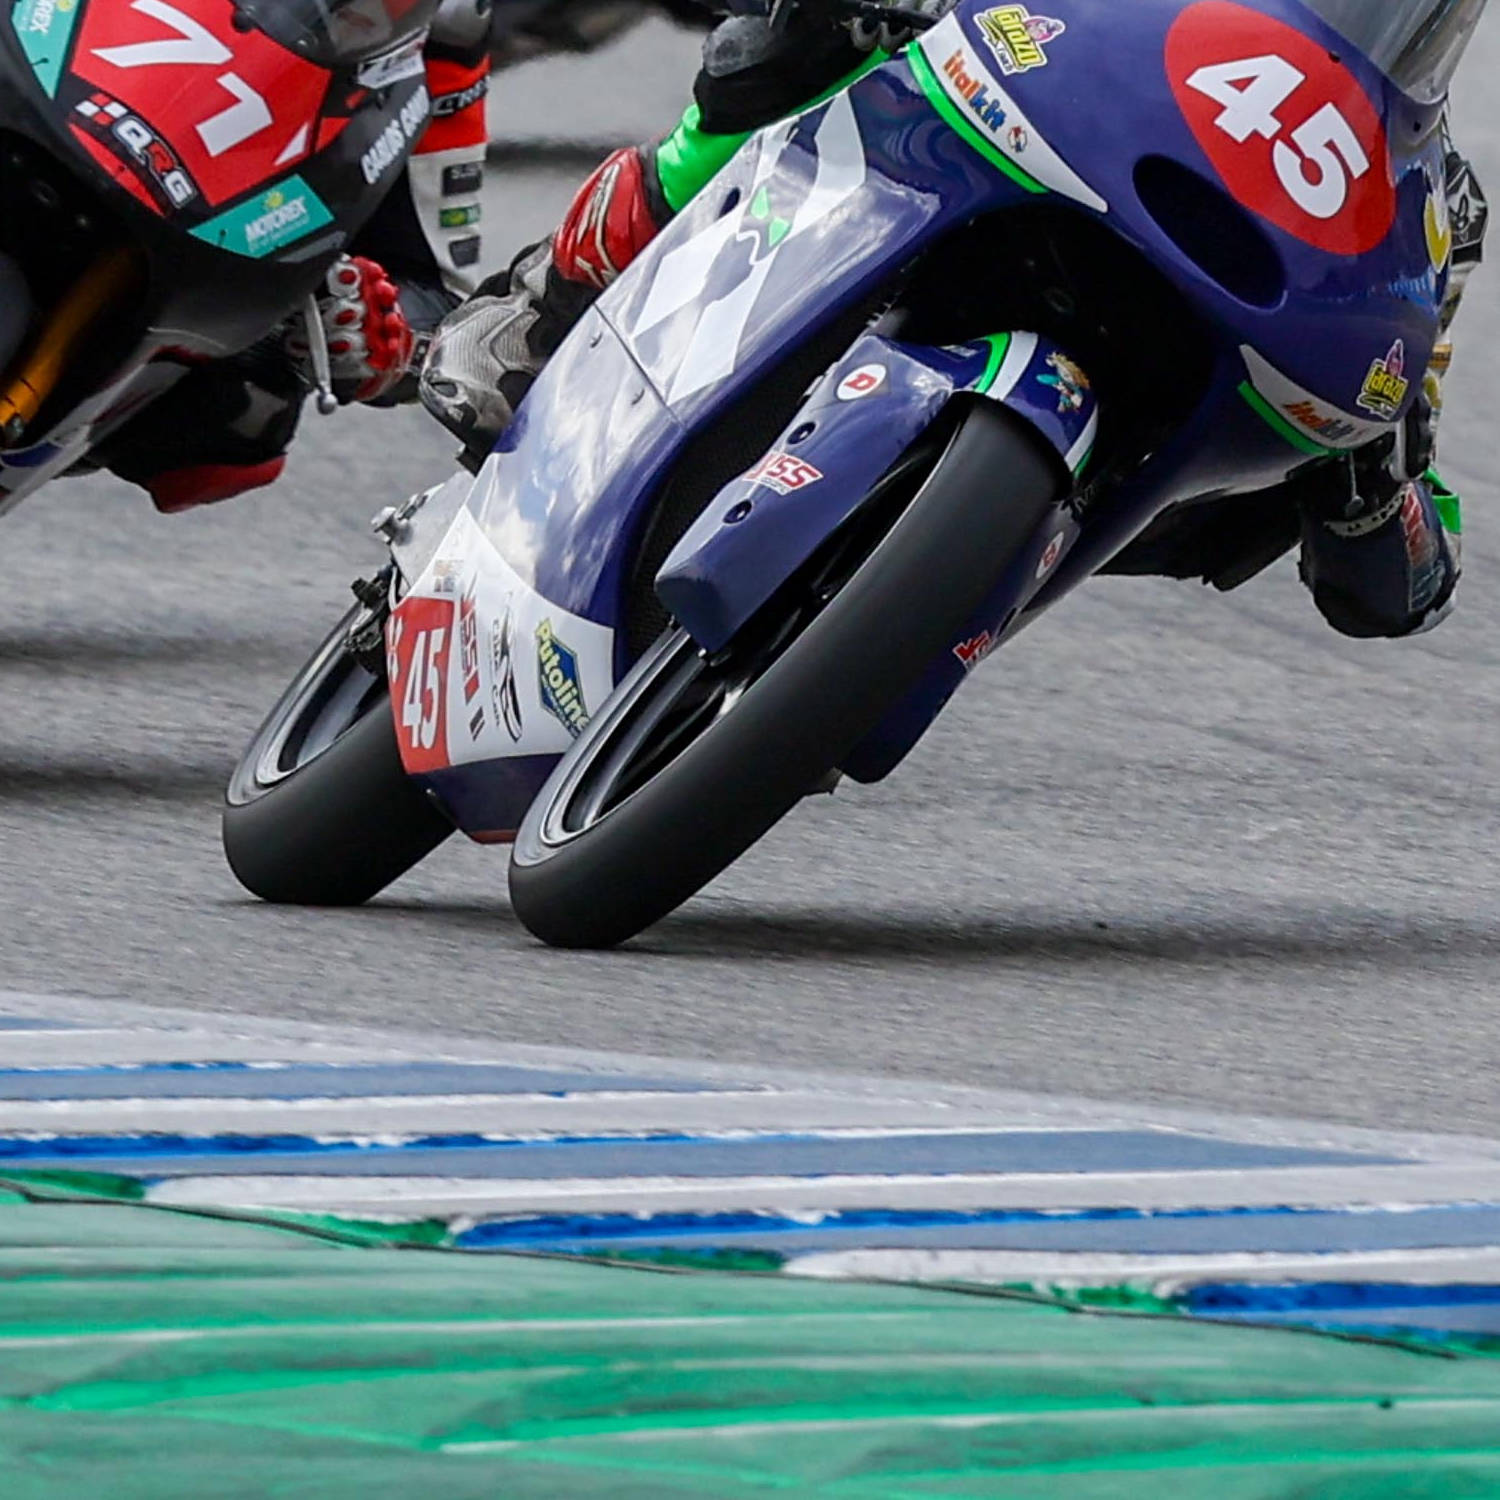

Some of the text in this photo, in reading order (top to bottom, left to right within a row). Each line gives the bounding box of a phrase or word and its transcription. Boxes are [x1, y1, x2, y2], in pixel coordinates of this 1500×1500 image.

[943, 50, 1007, 133] italkit
[1185, 54, 1370, 219] 45
[112, 116, 197, 209] QRG
[402, 627, 446, 749] 45
